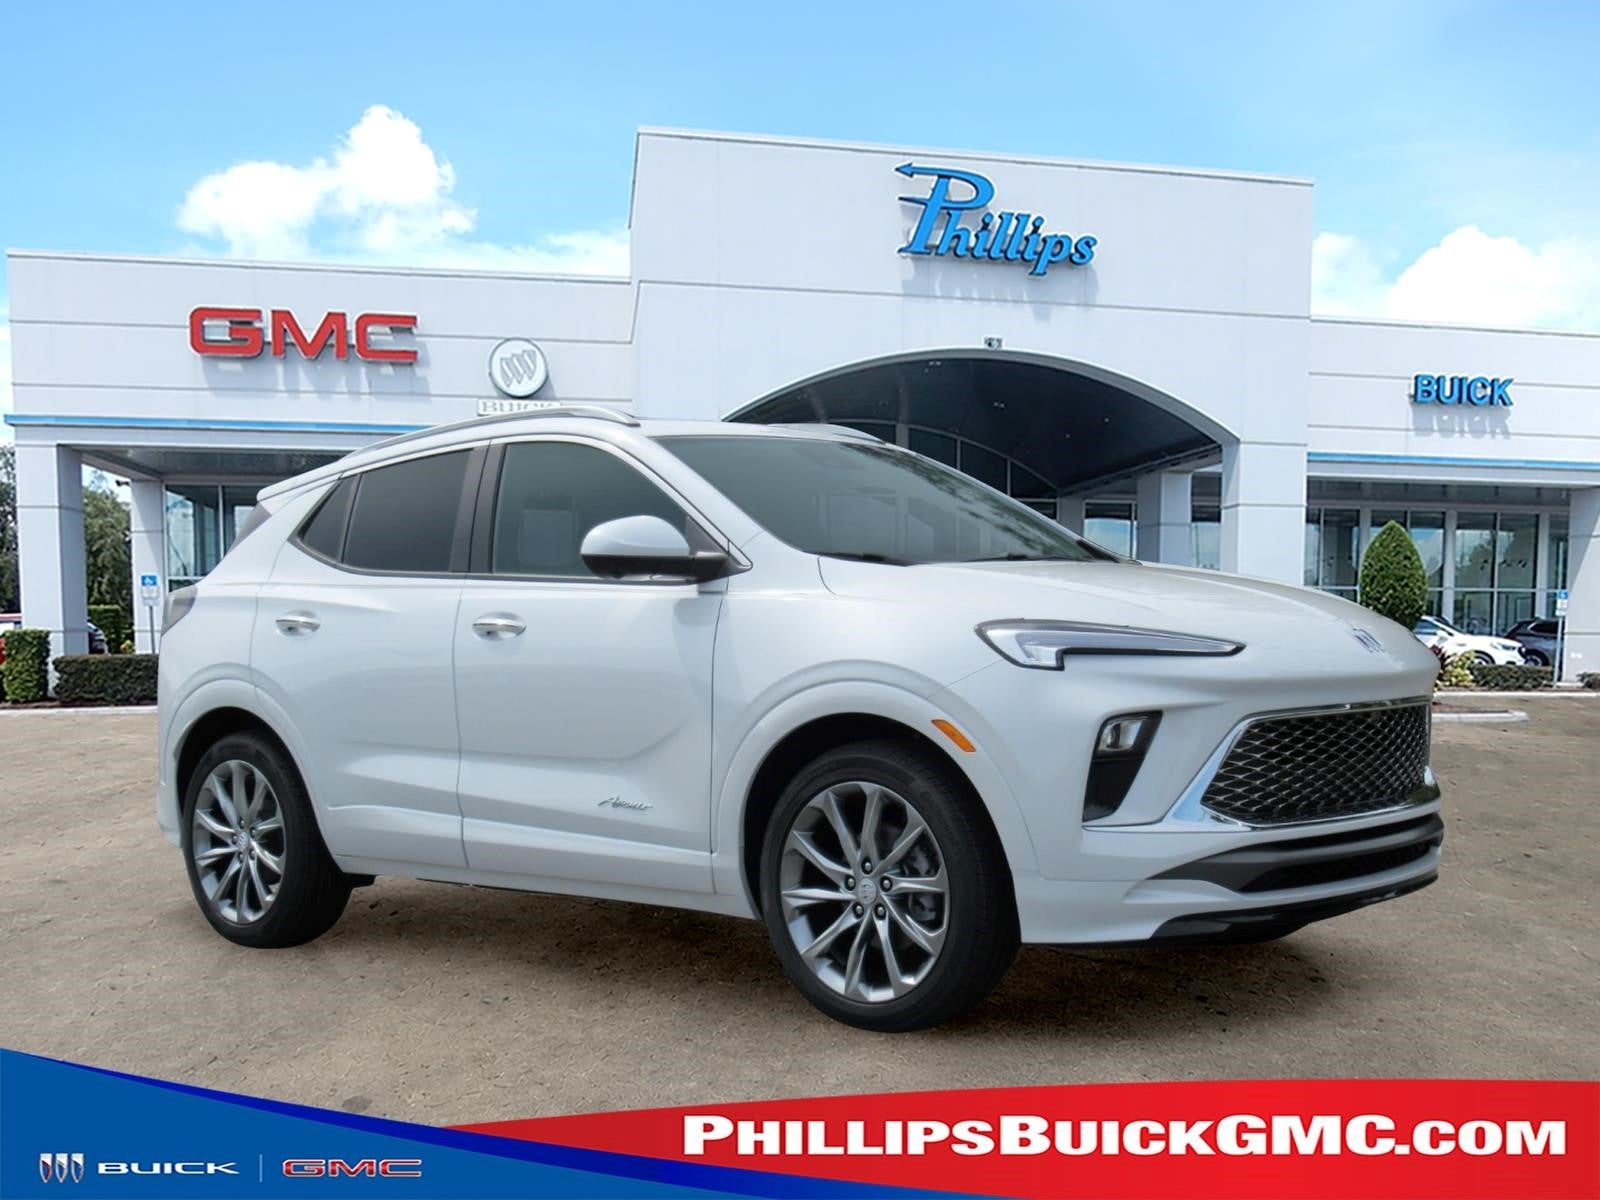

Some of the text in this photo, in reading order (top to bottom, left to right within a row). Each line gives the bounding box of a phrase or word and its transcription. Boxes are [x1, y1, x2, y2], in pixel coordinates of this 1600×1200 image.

[895, 162, 1098, 276] Phillips
[190, 306, 418, 363] GMC
[1414, 374, 1514, 406] BUICK
